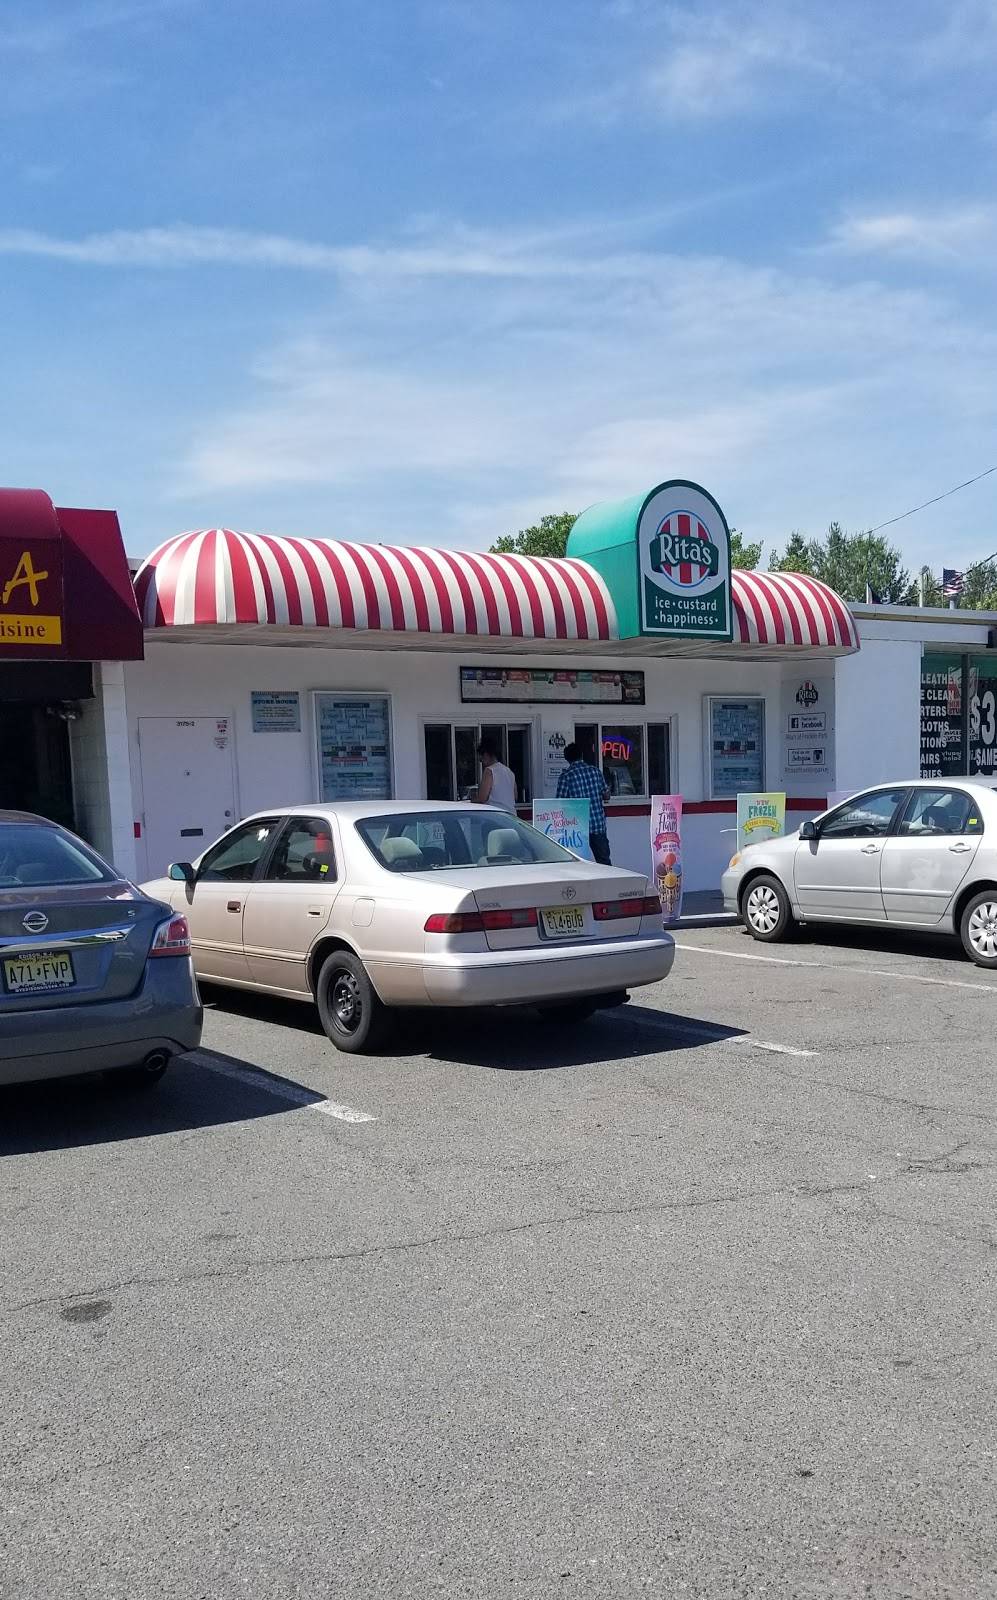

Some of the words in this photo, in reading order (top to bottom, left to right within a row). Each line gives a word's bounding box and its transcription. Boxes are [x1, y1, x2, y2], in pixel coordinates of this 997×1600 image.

[659, 533, 712, 566] Rita's
[655, 596, 670, 609] ice
[677, 599, 717, 611] custard
[659, 611, 714, 627] happiness
[0, 621, 46, 637] isine
[799, 689, 817, 700] Rita's
[926, 690, 955, 700] CLEAN
[920, 706, 947, 717] RTERS
[921, 721, 949, 732] LOTHS
[921, 737, 947, 748] TIONS
[976, 748, 997, 766] SAME
[748, 805, 777, 818] FROZEN
